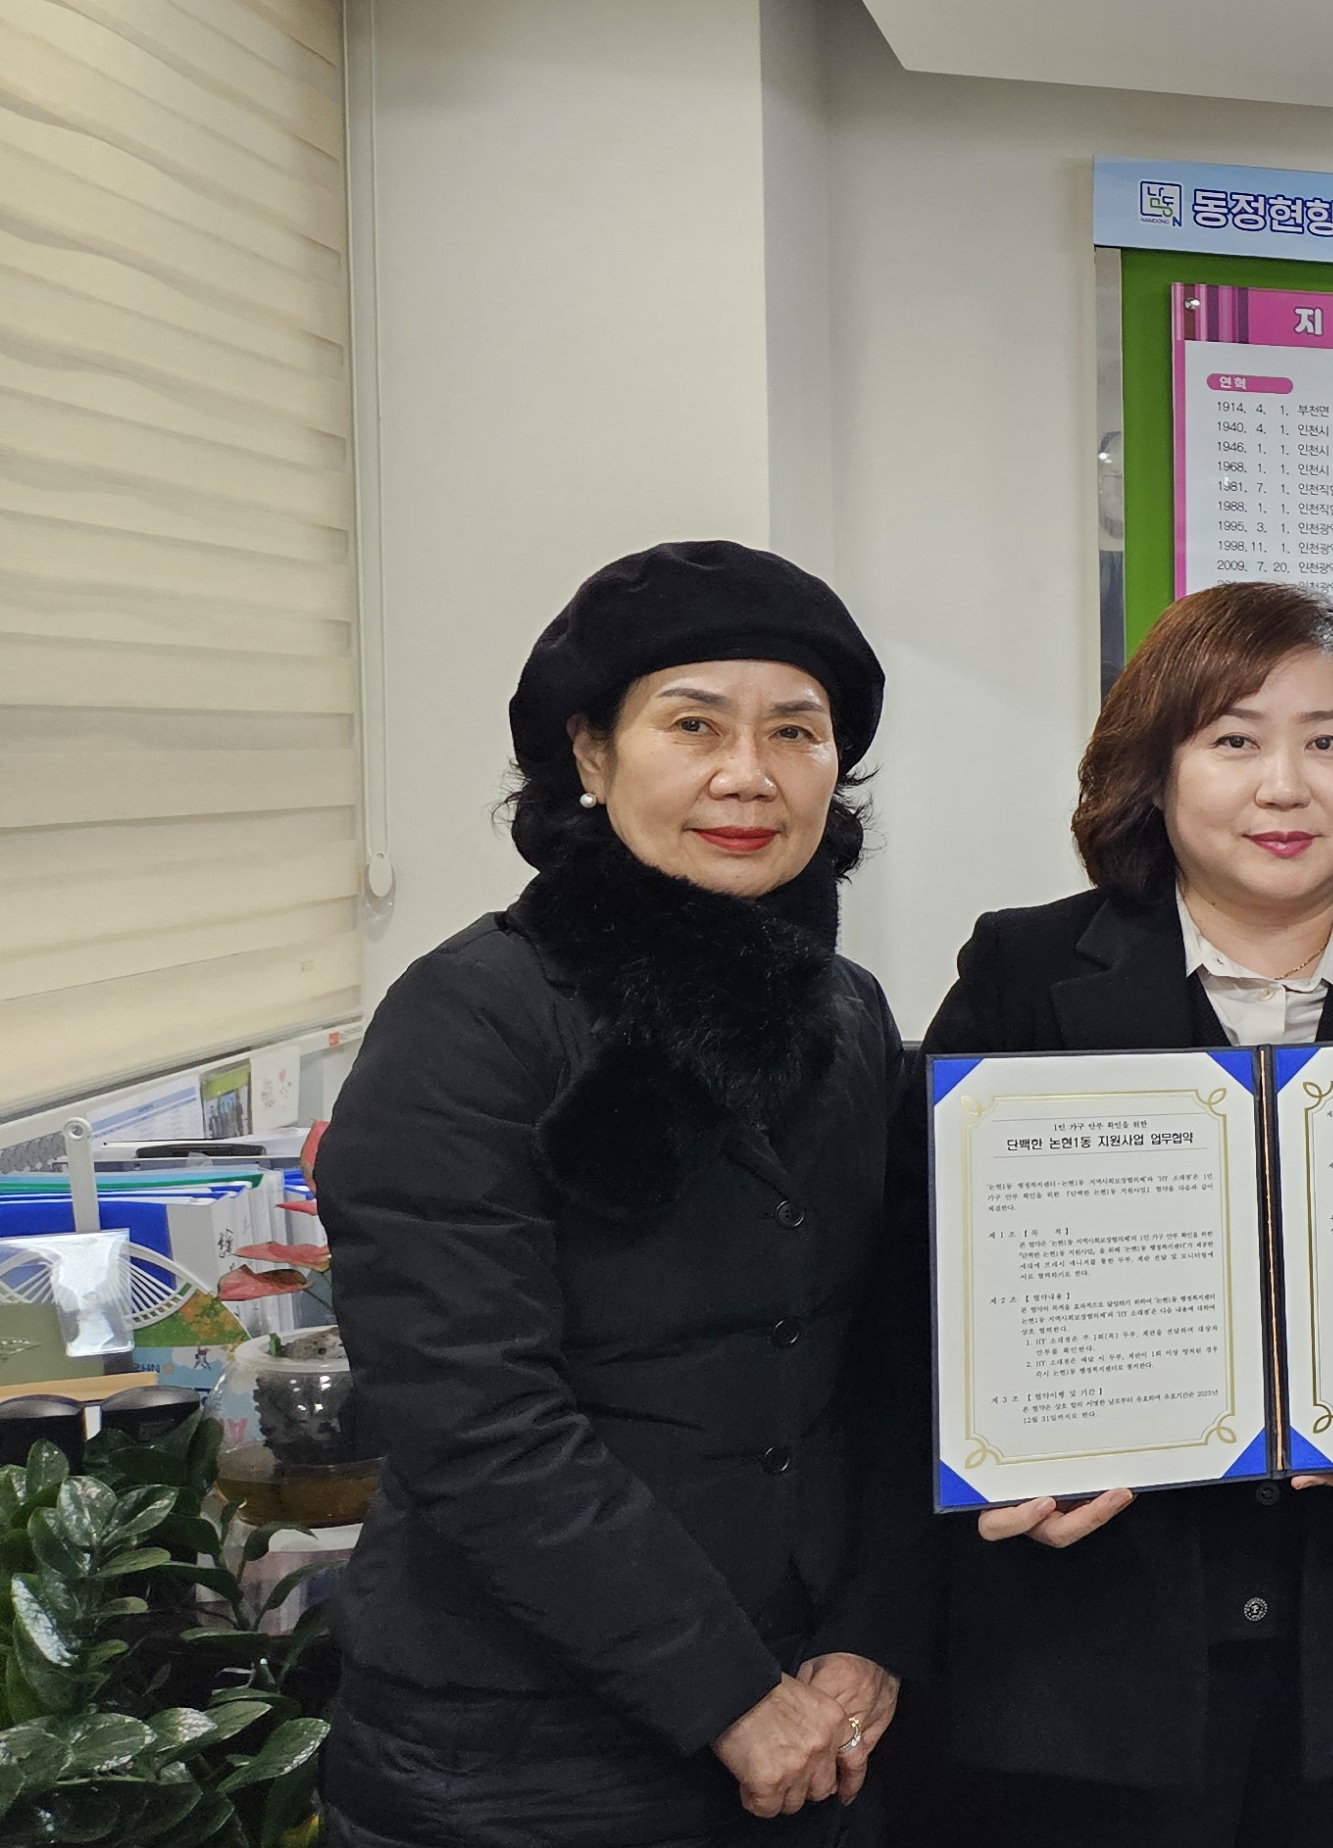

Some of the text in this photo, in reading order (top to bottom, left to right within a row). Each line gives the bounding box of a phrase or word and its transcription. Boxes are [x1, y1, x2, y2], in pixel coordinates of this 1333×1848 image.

[1218, 402, 1246, 413] 1914.
[1256, 404, 1266, 414] 4.
[1280, 405, 1289, 416] 1.
[1298, 405, 1329, 417] 부천면
[1218, 461, 1247, 473] 1968.
[1257, 463, 1267, 475] 1.
[1281, 464, 1289, 475] 1.
[1298, 464, 1329, 476] 인천시
[1219, 501, 1247, 512] 1988.
[1258, 503, 1267, 513] 1.
[1281, 504, 1289, 514] 1.
[1218, 521, 1247, 532] 1995.
[1256, 523, 1268, 534] 3.
[1280, 524, 1290, 535] 1.
[1219, 541, 1247, 552] 1998.
[1252, 542, 1267, 553] 11.
[1280, 543, 1290, 555] 1.
[1217, 560, 1247, 571] 2009.
[1257, 561, 1269, 573] 7.
[1273, 562, 1290, 573] 20.
[1054, 1120, 1147, 1131] 1인 가구 안부 확인을 위한
[1007, 1132, 1193, 1151] 단백한 논현1동 지원사업 업무협약
